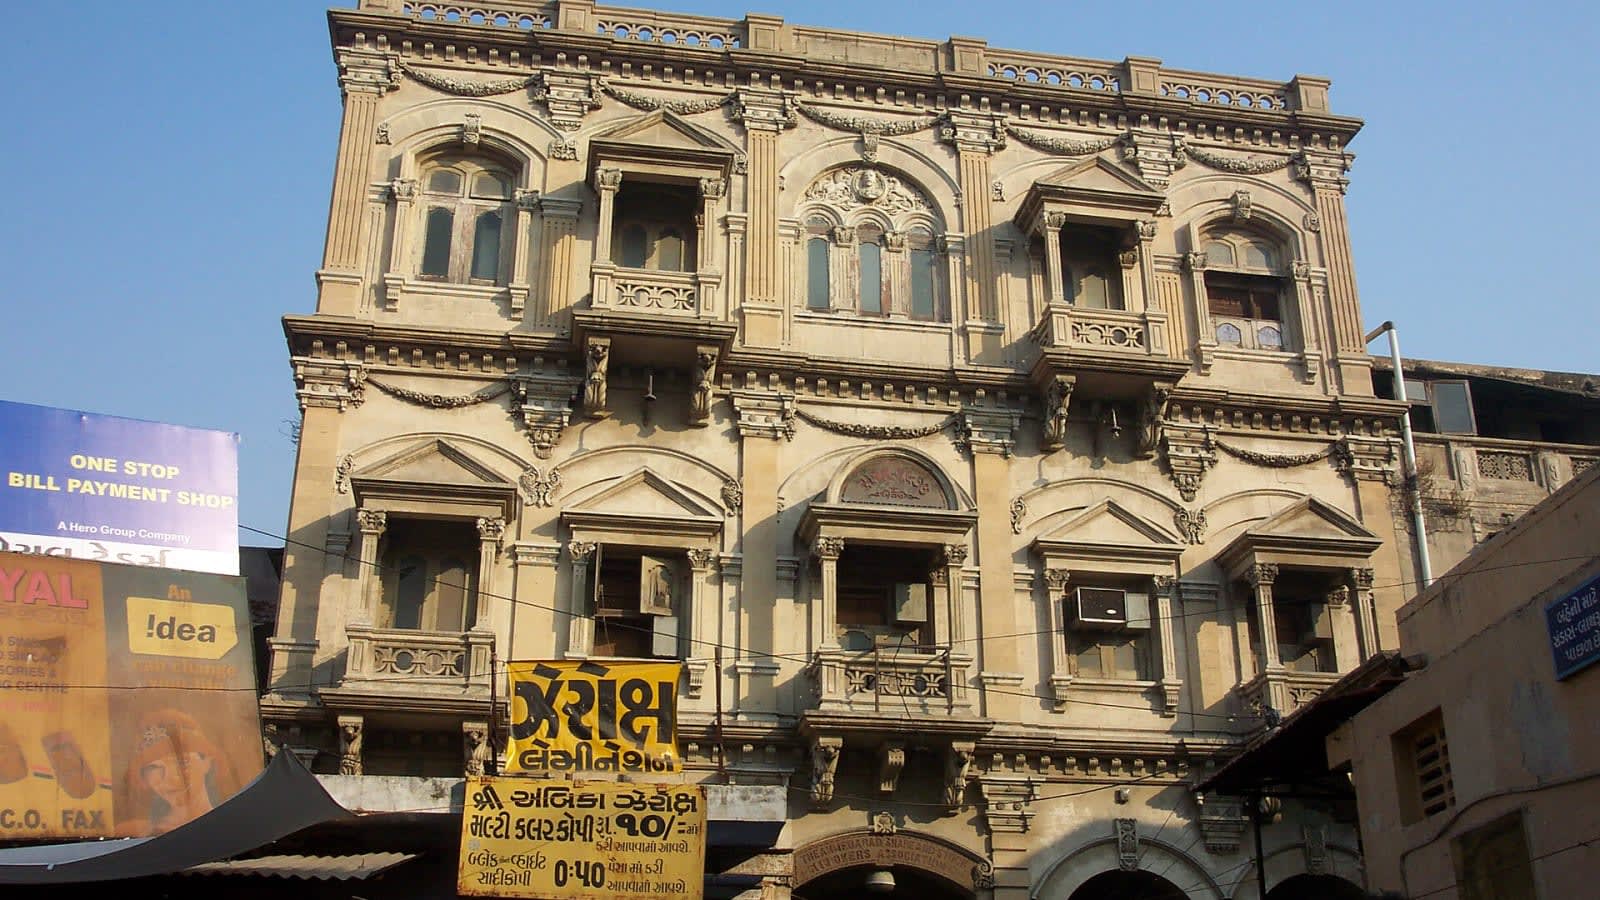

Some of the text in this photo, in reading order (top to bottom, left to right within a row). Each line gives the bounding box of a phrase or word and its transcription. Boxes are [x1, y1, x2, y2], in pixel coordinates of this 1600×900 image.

[70, 454, 180, 480] ONE STOP
[8, 472, 234, 508] BILL PAYMENT SHOP
[57, 521, 191, 543] A Hero Group Company
[473, 785, 504, 811] શ્રી
[62, 809, 104, 830] FAX
[470, 811, 510, 840] મલ્ટી
